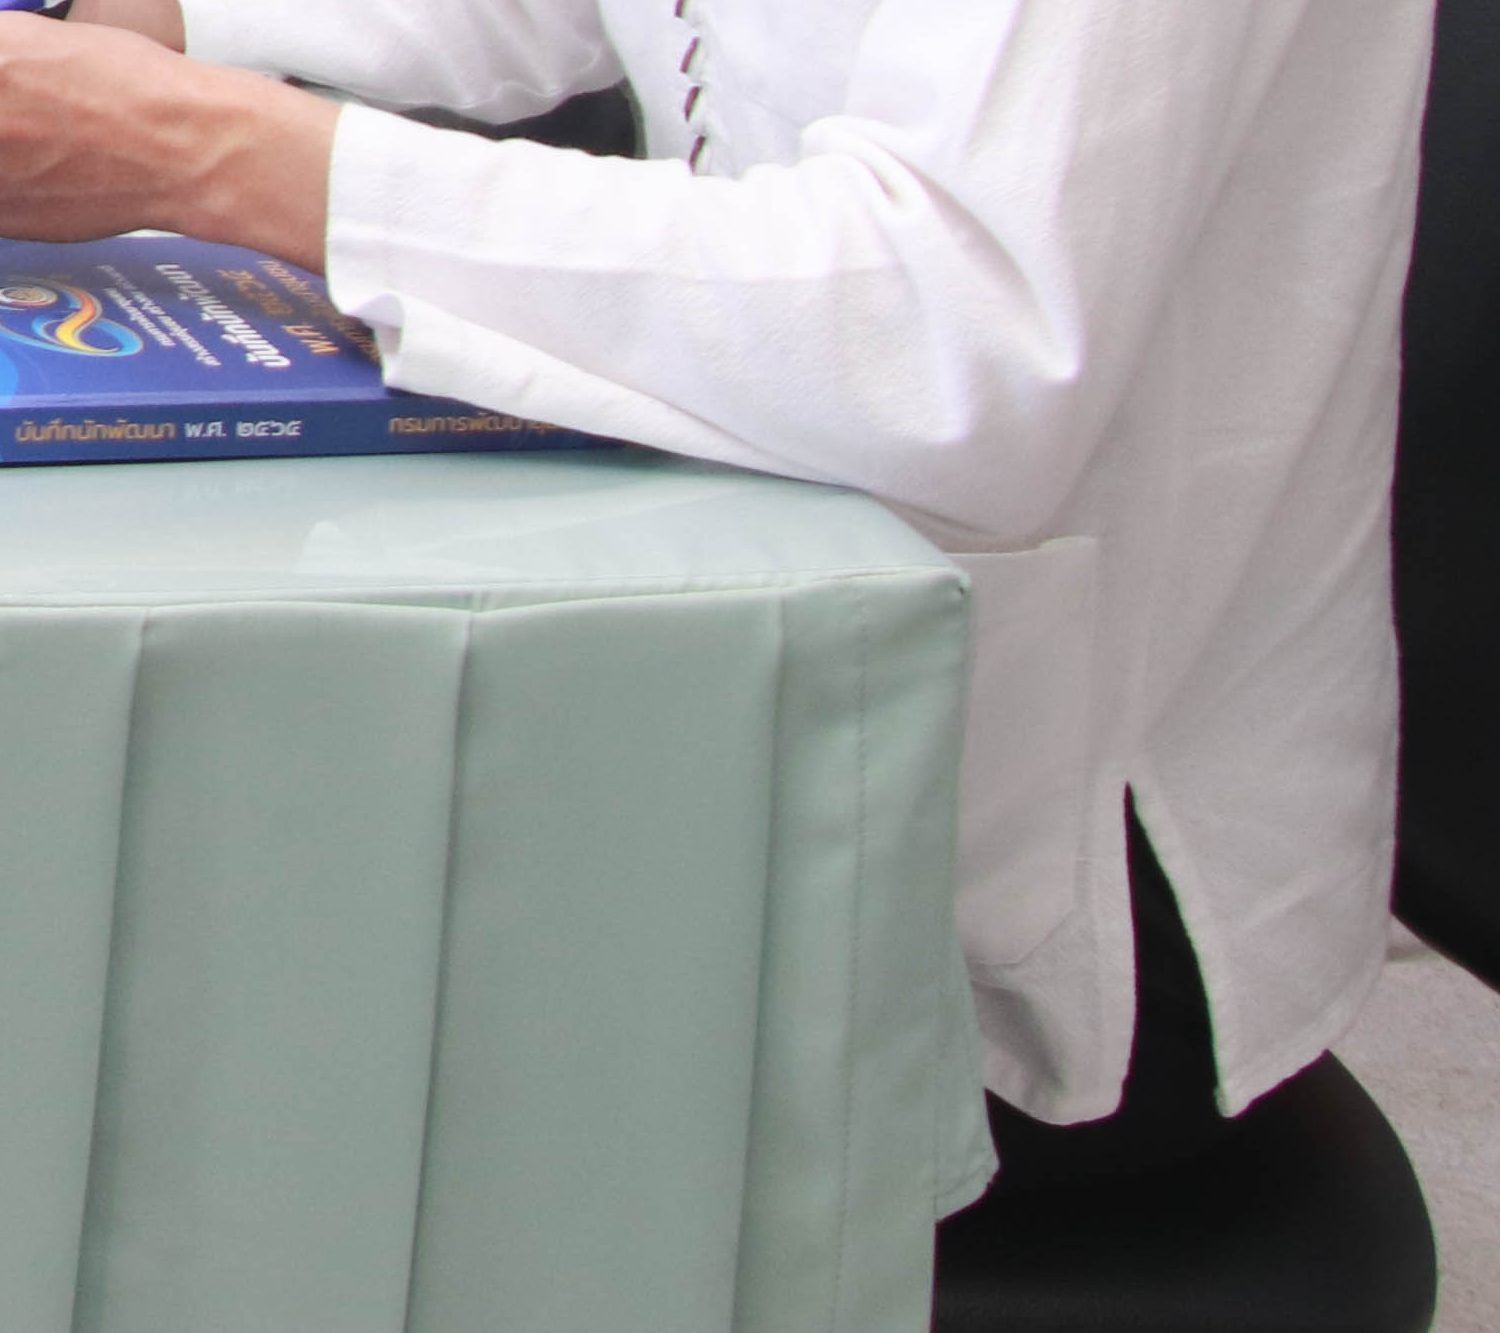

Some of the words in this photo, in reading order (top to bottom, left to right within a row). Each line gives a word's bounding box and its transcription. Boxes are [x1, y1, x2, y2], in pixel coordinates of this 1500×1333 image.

[14, 416, 176, 444] บันทึกนักพัฒนา
[184, 420, 228, 440] พ.ศ.
